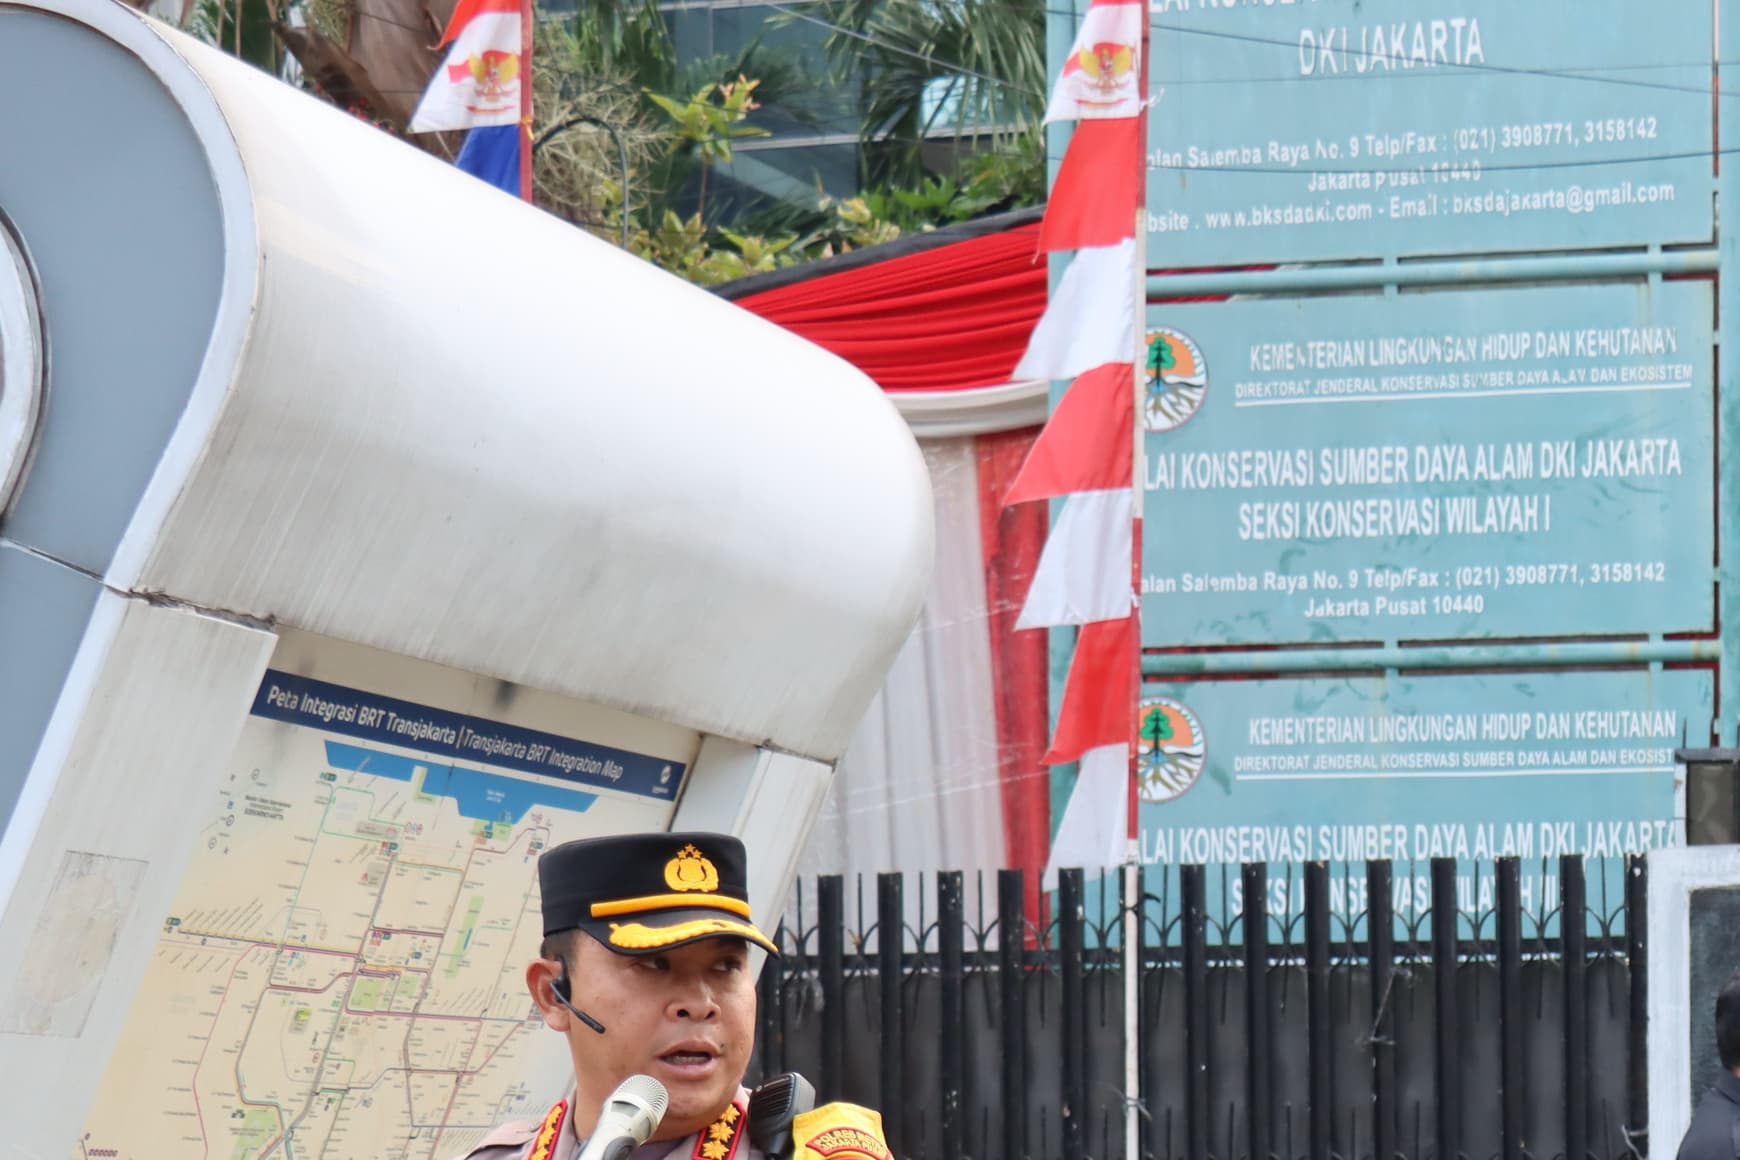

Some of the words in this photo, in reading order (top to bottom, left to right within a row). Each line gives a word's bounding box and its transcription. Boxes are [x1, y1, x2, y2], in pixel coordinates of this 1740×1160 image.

[1300, 26, 1347, 75] DKI
[1355, 18, 1485, 73] JAKARTA
[1188, 145, 1262, 168] Salemba
[1268, 141, 1310, 166] Raya
[1316, 139, 1344, 160] No.
[1350, 136, 1359, 158] 9
[1365, 132, 1437, 159] Telp/Fax
[1453, 127, 1496, 153] (021)
[1502, 122, 1580, 147] 3908771,
[1584, 117, 1657, 143] 3158142
[1308, 170, 1371, 192] Jakarta
[1148, 211, 1189, 233] bsite
[1390, 195, 1437, 219] Email
[1370, 335, 1477, 366] LINGKUNGAN
[1482, 331, 1531, 361] HIDUP
[1536, 329, 1571, 358] DAN
[1576, 327, 1677, 358] KEHUTANAN
[1235, 381, 1311, 399] DIREKTORAT
[1314, 378, 1378, 396] JENDERAL
[1381, 372, 1460, 392] KONSERVASI
[1463, 370, 1513, 389] SUMBER
[1517, 368, 1549, 385] DAYA
[1591, 367, 1617, 382] DAN
[1621, 364, 1693, 382] EKOSISTEM
[1144, 452, 1176, 491] LAI
[1181, 448, 1314, 490] KONSERVASI
[1320, 445, 1409, 487] SUMBER
[1415, 443, 1469, 482] DAYA
[1473, 441, 1533, 481] ALAM
[1540, 440, 1576, 479] DKI
[1582, 438, 1682, 478] JAKARTA
[1239, 502, 1299, 540] SEKSI
[1306, 497, 1440, 539] KONSERVASI
[1447, 494, 1538, 534] WILAYAH
[1545, 494, 1550, 531] I
[1141, 574, 1176, 593] alan
[1181, 572, 1258, 592] Salemba
[1263, 571, 1307, 595] Raya
[1313, 571, 1342, 590] No.
[1349, 570, 1358, 589] 9
[1364, 567, 1439, 592] Telp/Fax
[1456, 566, 1500, 590] (021)
[1505, 564, 1584, 587] 3908771,
[1591, 562, 1665, 583] 3158142
[1304, 598, 1369, 618] Jakarta
[1375, 596, 1426, 616] Pusat
[1432, 594, 1484, 614] 10440
[266, 685, 299, 710] Peta
[301, 692, 359, 723] Integrasi
[358, 705, 385, 729] BRT
[386, 711, 456, 745] Transjakarta
[463, 728, 527, 760] Transjakarta
[526, 743, 551, 764] BRT
[548, 746, 603, 775] Integration
[601, 759, 624, 782] Map
[1250, 717, 1365, 745] KEMENTERIAN
[1369, 714, 1477, 743] LINGKUNGAN
[1482, 712, 1531, 741] HIDUP
[1536, 711, 1570, 739] DAN
[1575, 710, 1676, 739] KEHUTANAN
[1234, 755, 1310, 772] DIREKTORAT
[1313, 754, 1377, 770] JENDERAL
[1381, 752, 1459, 769] KONSERVASI
[1463, 751, 1514, 767] SUMBER
[1518, 750, 1549, 766] DAYA
[1553, 750, 1586, 765] ALAM
[1591, 749, 1616, 764] DAN
[1621, 748, 1674, 764] EKOSIST
[1180, 825, 1313, 863] KONSERVASI
[1319, 823, 1408, 861] SUMBER
[1415, 822, 1469, 860] DAYA
[1474, 822, 1533, 860] ALAM
[1540, 821, 1576, 858] DKI
[1581, 819, 1677, 858] JAKARTA
